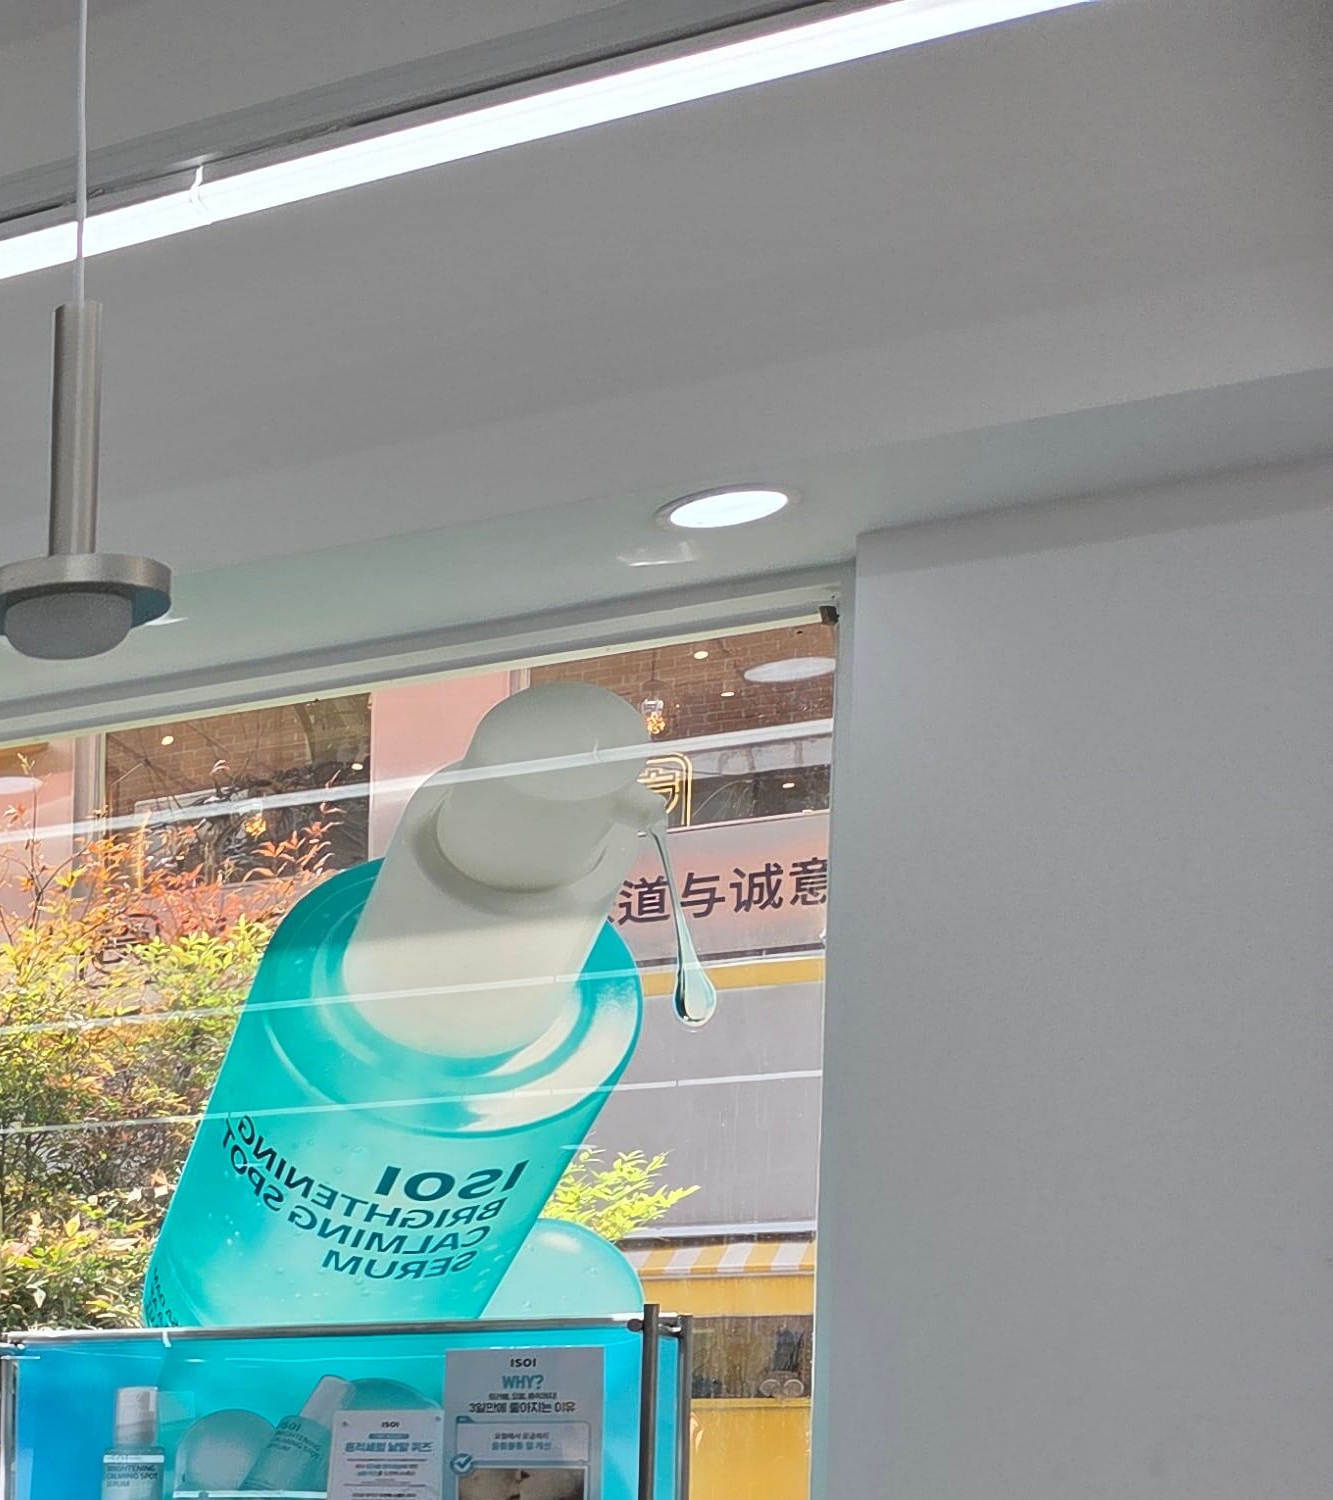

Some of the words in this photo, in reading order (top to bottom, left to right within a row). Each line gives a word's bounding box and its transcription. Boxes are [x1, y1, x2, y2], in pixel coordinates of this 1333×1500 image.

[608, 857, 828, 926] 道与诚意
[510, 1358, 536, 1367] ISOI
[502, 1375, 544, 1389] WHY?
